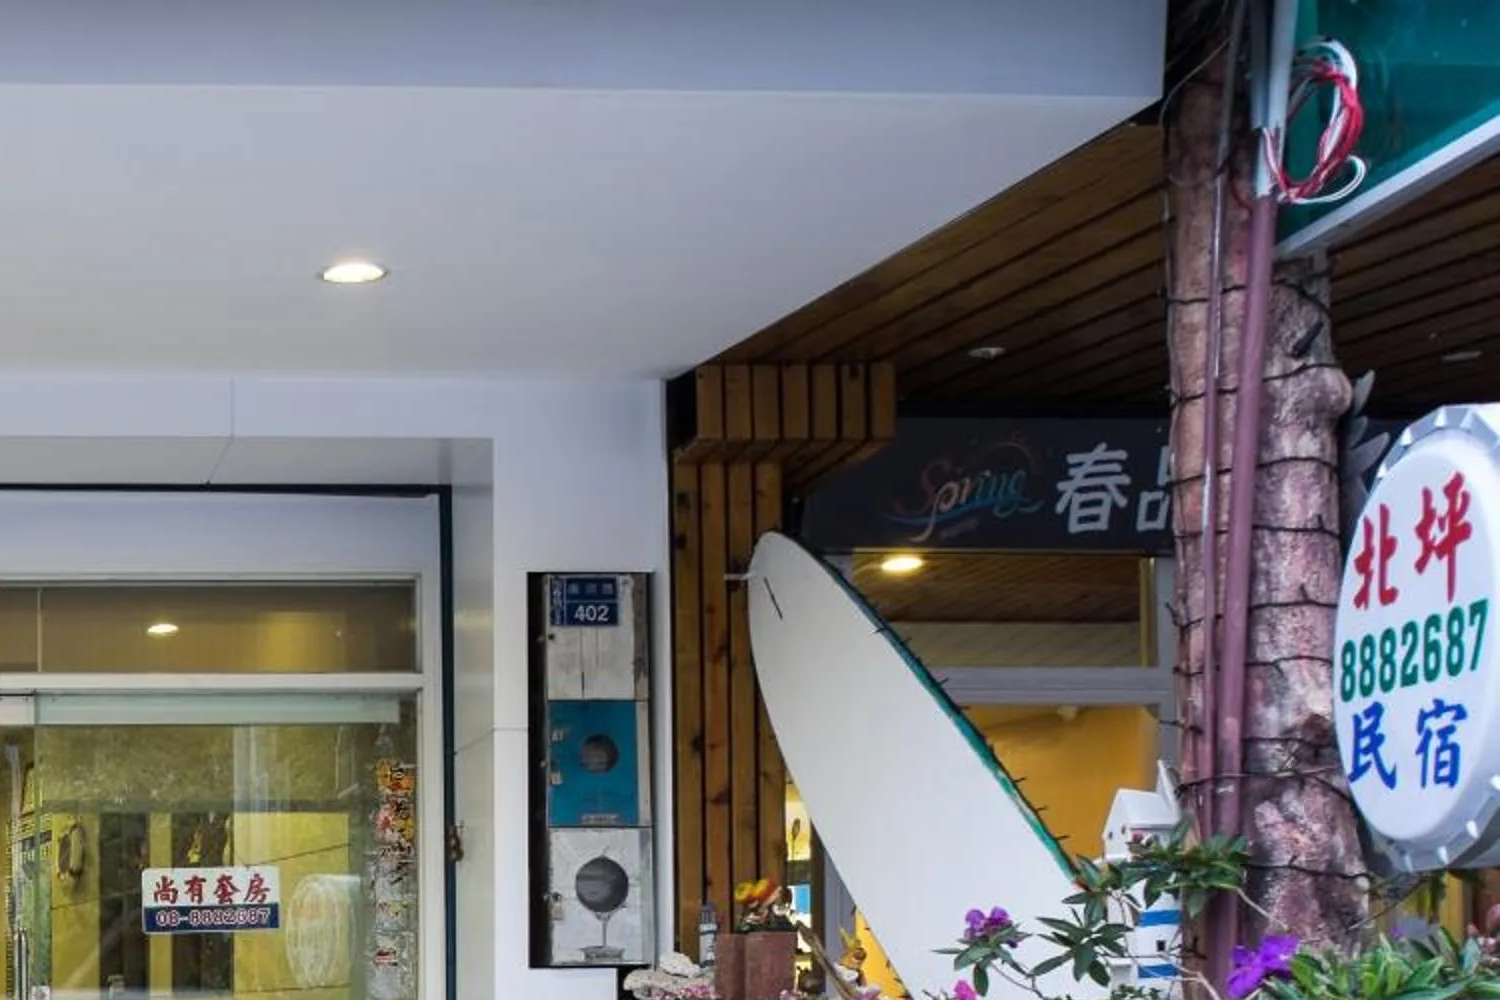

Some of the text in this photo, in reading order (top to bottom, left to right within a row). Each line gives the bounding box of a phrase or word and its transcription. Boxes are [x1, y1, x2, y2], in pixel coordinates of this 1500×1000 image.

[1353, 471, 1472, 611] 北坪
[574, 605, 610, 622] 402
[1340, 598, 1490, 703] 8882687
[1347, 698, 1468, 790] 民宿
[153, 873, 270, 904] 尚有套房
